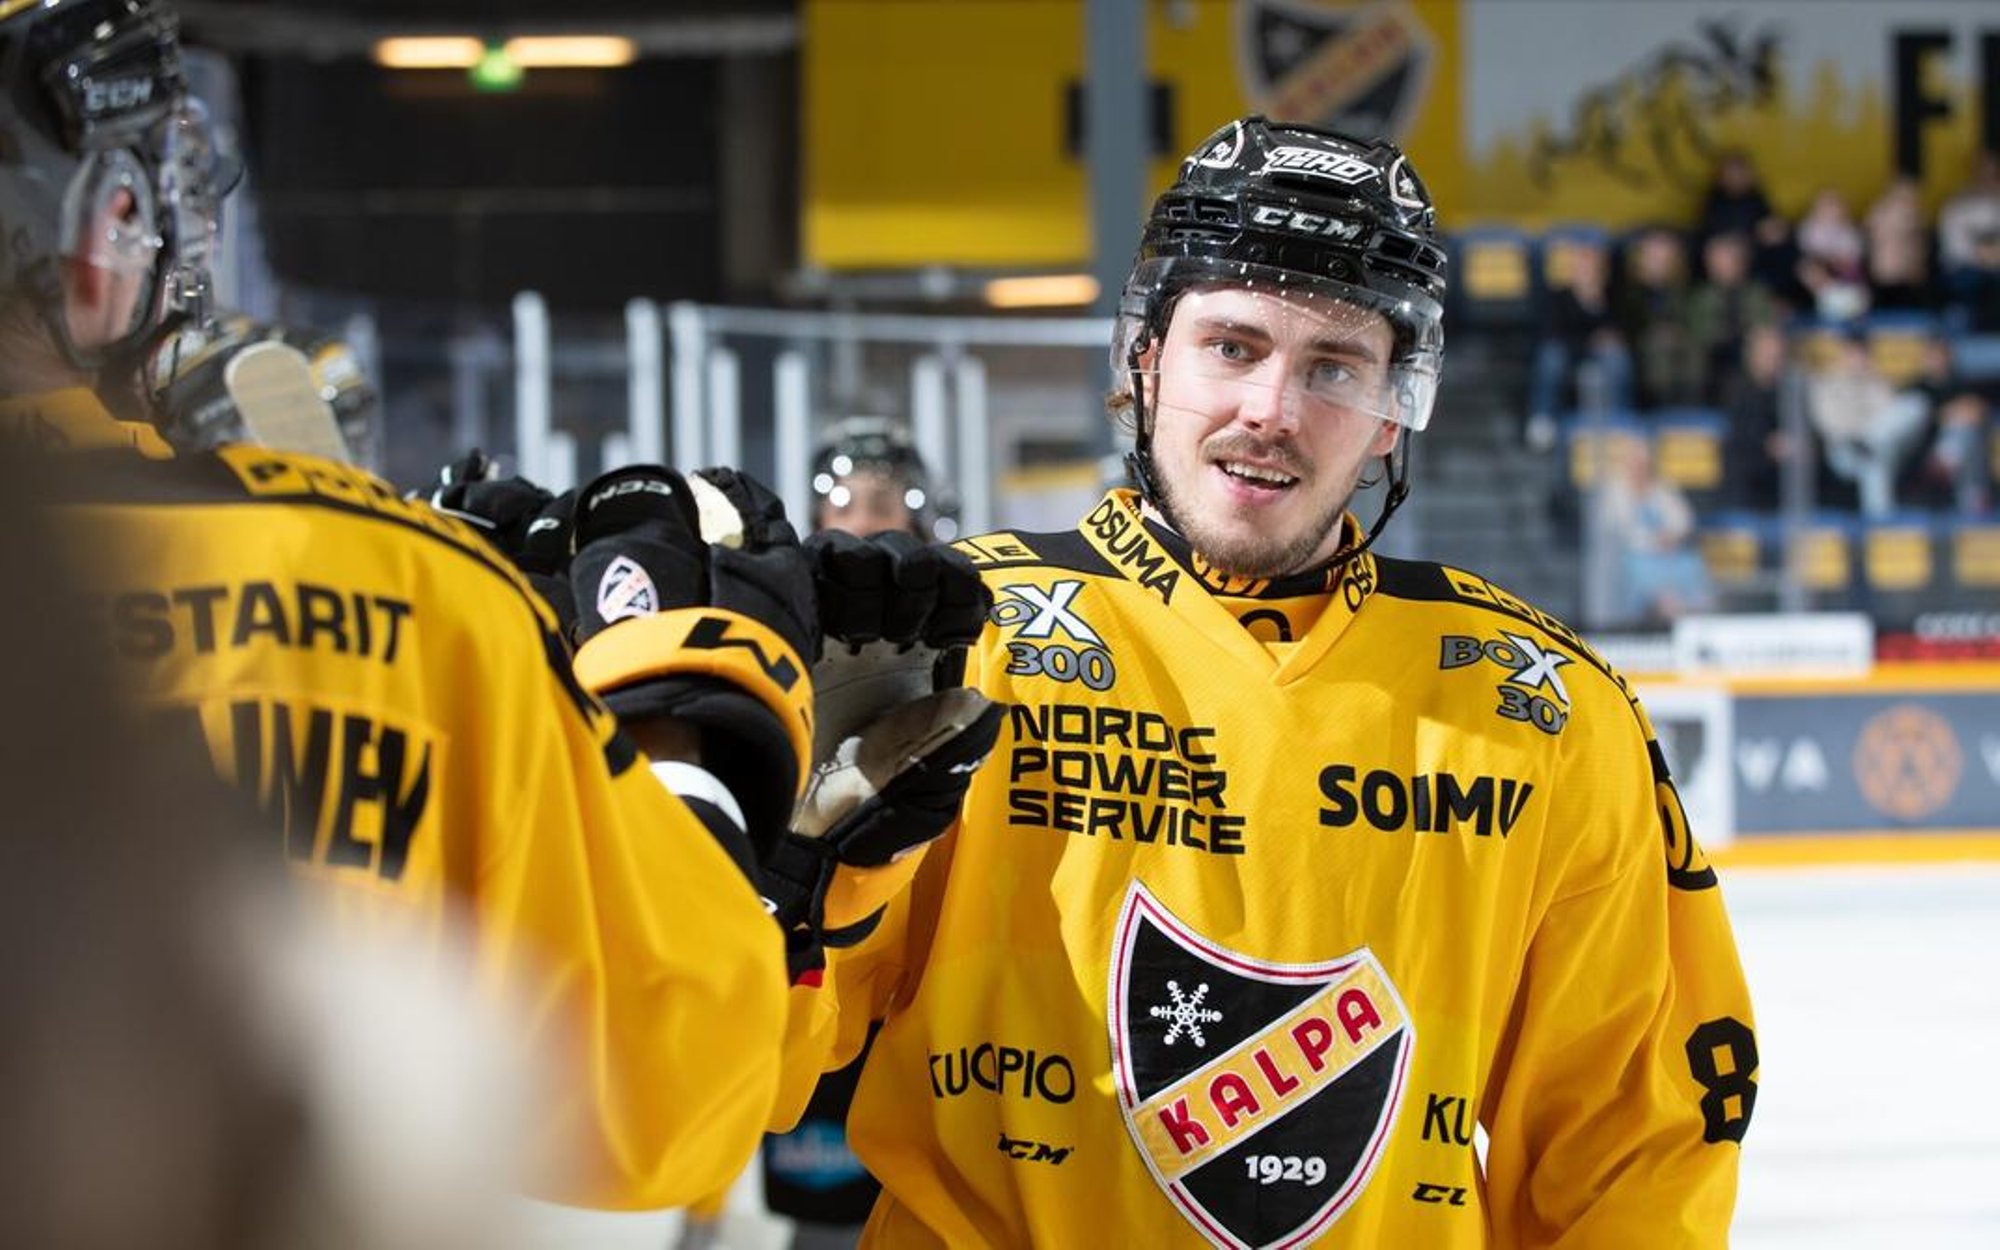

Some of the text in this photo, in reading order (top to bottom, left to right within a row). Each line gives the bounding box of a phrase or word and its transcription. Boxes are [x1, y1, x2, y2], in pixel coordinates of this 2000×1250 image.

[1252, 205, 1363, 241] CCM
[1087, 498, 1180, 606] OSUMA
[987, 580, 1113, 655] OX
[1006, 642, 1115, 692] 300
[1440, 629, 1575, 706] BOX
[1496, 685, 1567, 735] 30
[1010, 747, 1226, 809] POWER
[1009, 789, 1246, 855] SERVICE
[1159, 988, 1383, 1155] KALPA
[1685, 1016, 1759, 1145] 8
[1246, 1155, 1327, 1185] 1929
